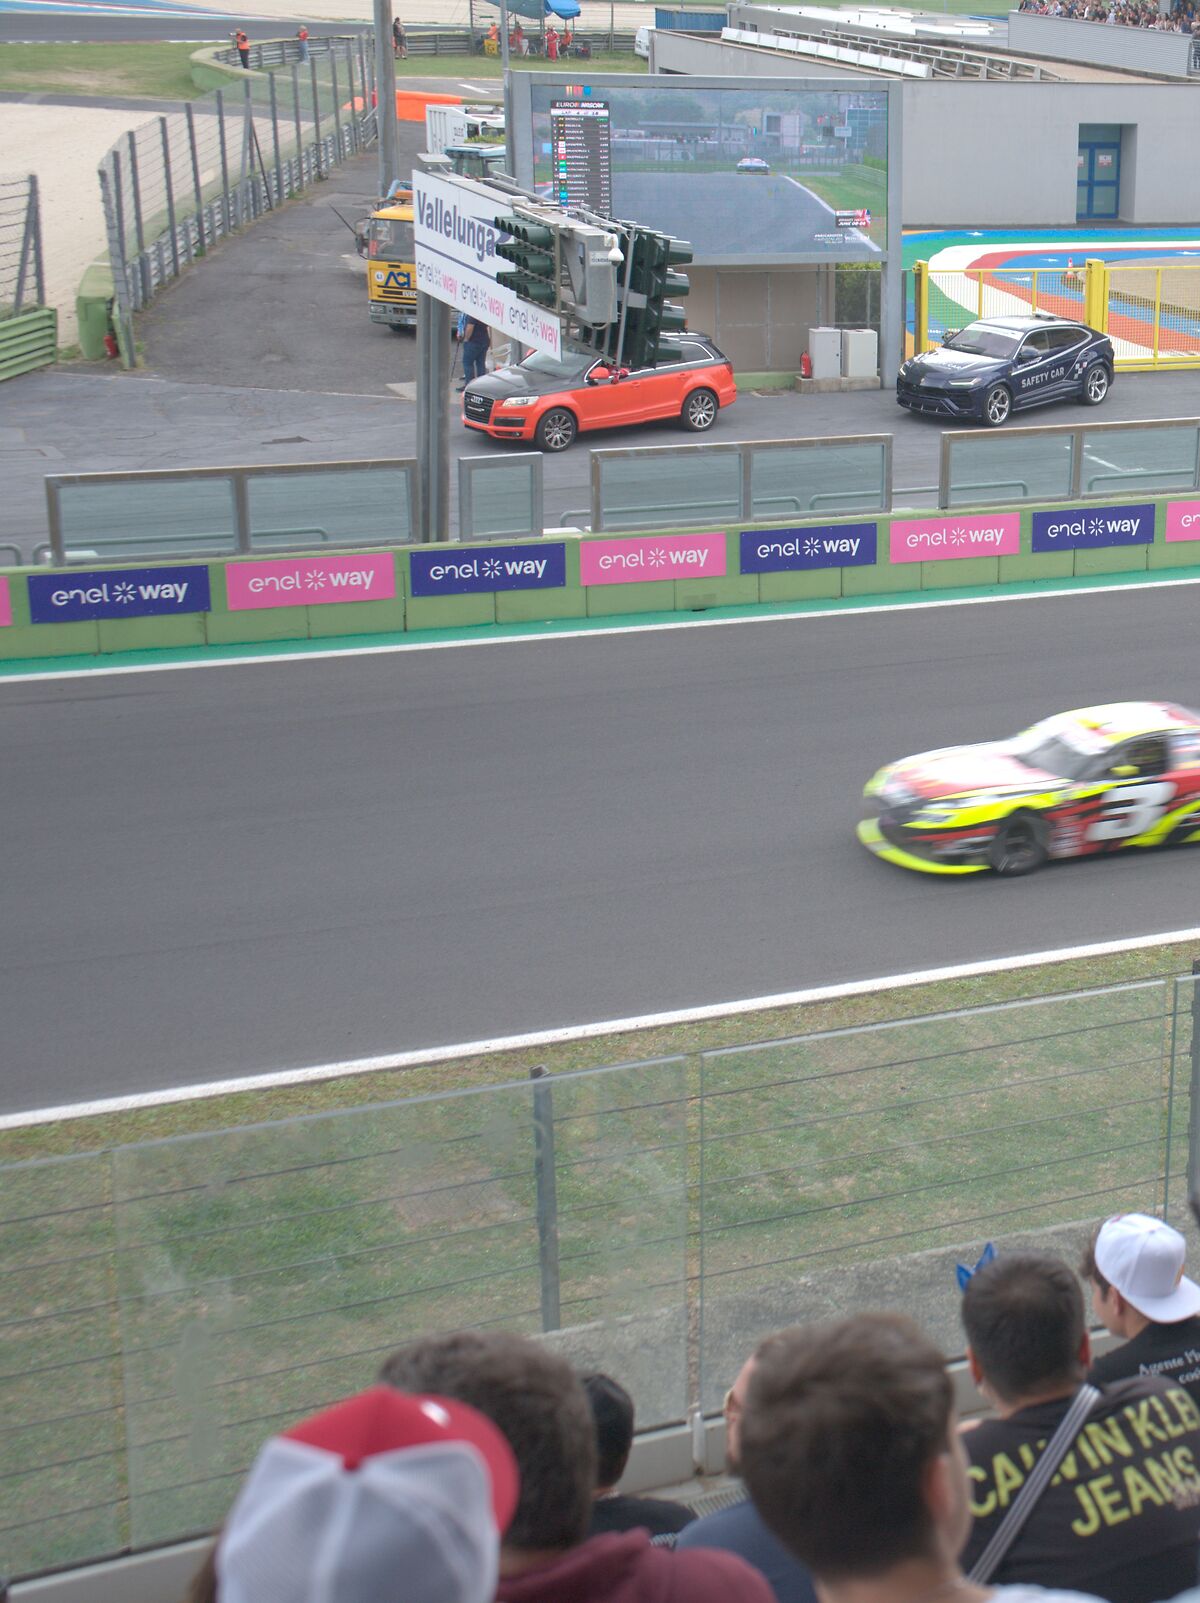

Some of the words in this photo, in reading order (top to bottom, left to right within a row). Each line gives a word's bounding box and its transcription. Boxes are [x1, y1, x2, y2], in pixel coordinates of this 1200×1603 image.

[417, 190, 495, 262] Vallelunga
[384, 271, 411, 288] ACI
[417, 260, 434, 284] enel
[442, 276, 457, 295] way
[461, 282, 479, 306] enel
[488, 298, 505, 324] way
[509, 306, 529, 333] enel
[540, 322, 558, 352] way
[1021, 373, 1049, 388] SAFETY
[1050, 367, 1065, 380] CAR
[906, 528, 947, 548] enel
[969, 527, 1004, 545] way
[1047, 519, 1085, 538] enel
[1106, 518, 1140, 536] way
[599, 549, 644, 569] enel
[669, 548, 708, 567] way
[757, 538, 799, 558] enel
[823, 537, 860, 556] way
[248, 571, 301, 593] enel
[329, 569, 374, 589] way
[430, 559, 479, 581] enel
[504, 558, 547, 578] way
[51, 583, 110, 606] enel
[138, 582, 189, 602] way
[1086, 780, 1179, 841] 3
[1123, 1388, 1200, 1450] KLE
